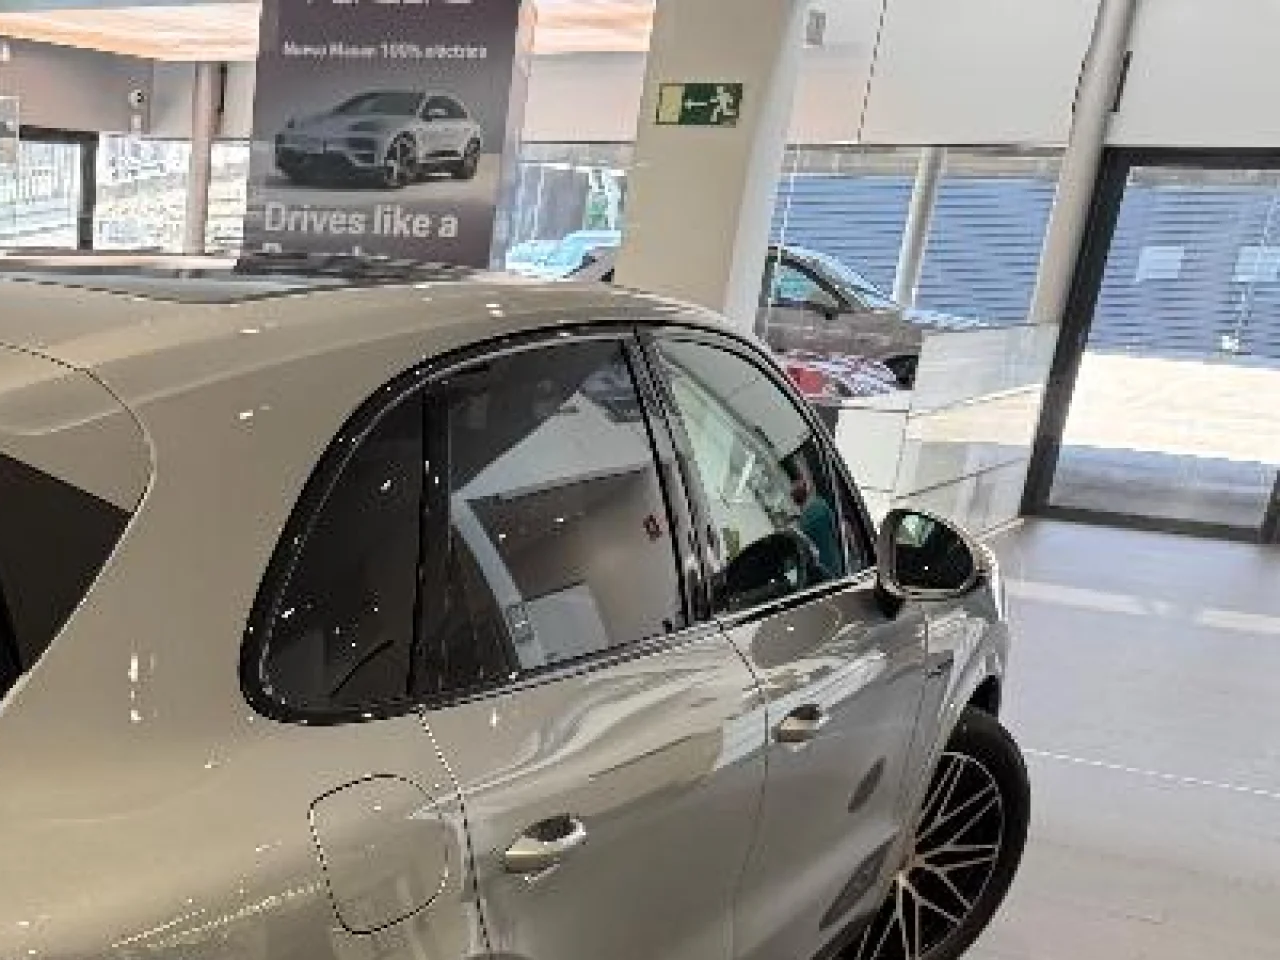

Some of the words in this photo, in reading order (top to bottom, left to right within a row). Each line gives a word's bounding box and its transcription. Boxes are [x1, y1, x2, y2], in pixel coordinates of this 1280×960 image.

[265, 202, 366, 234] Drives
[372, 204, 432, 237] like
[438, 213, 458, 237] a
